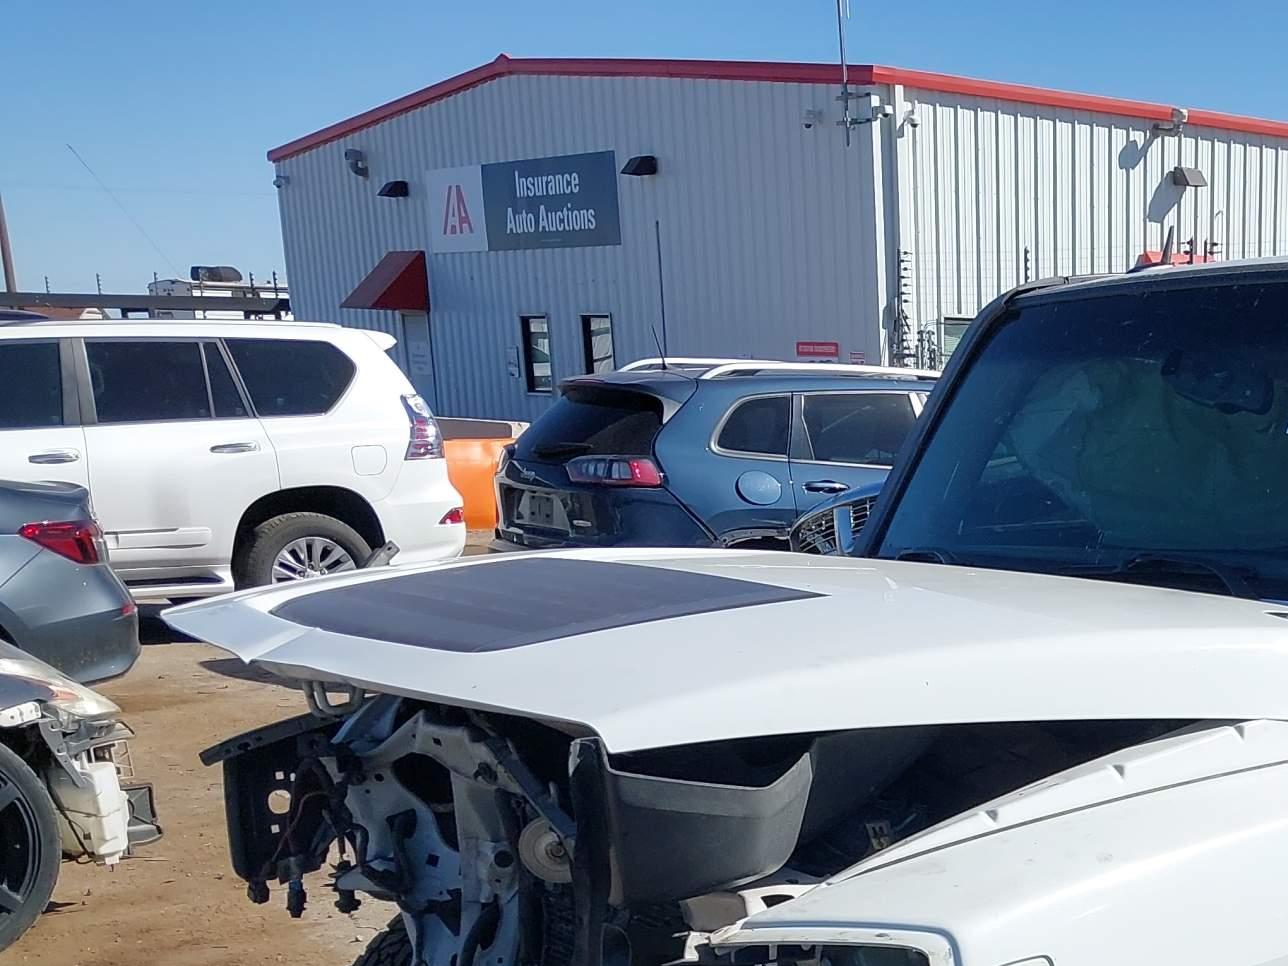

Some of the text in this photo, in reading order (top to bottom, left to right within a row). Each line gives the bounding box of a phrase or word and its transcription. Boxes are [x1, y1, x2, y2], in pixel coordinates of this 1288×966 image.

[514, 170, 579, 198] Insurance
[506, 203, 596, 234] Auto Auctions
